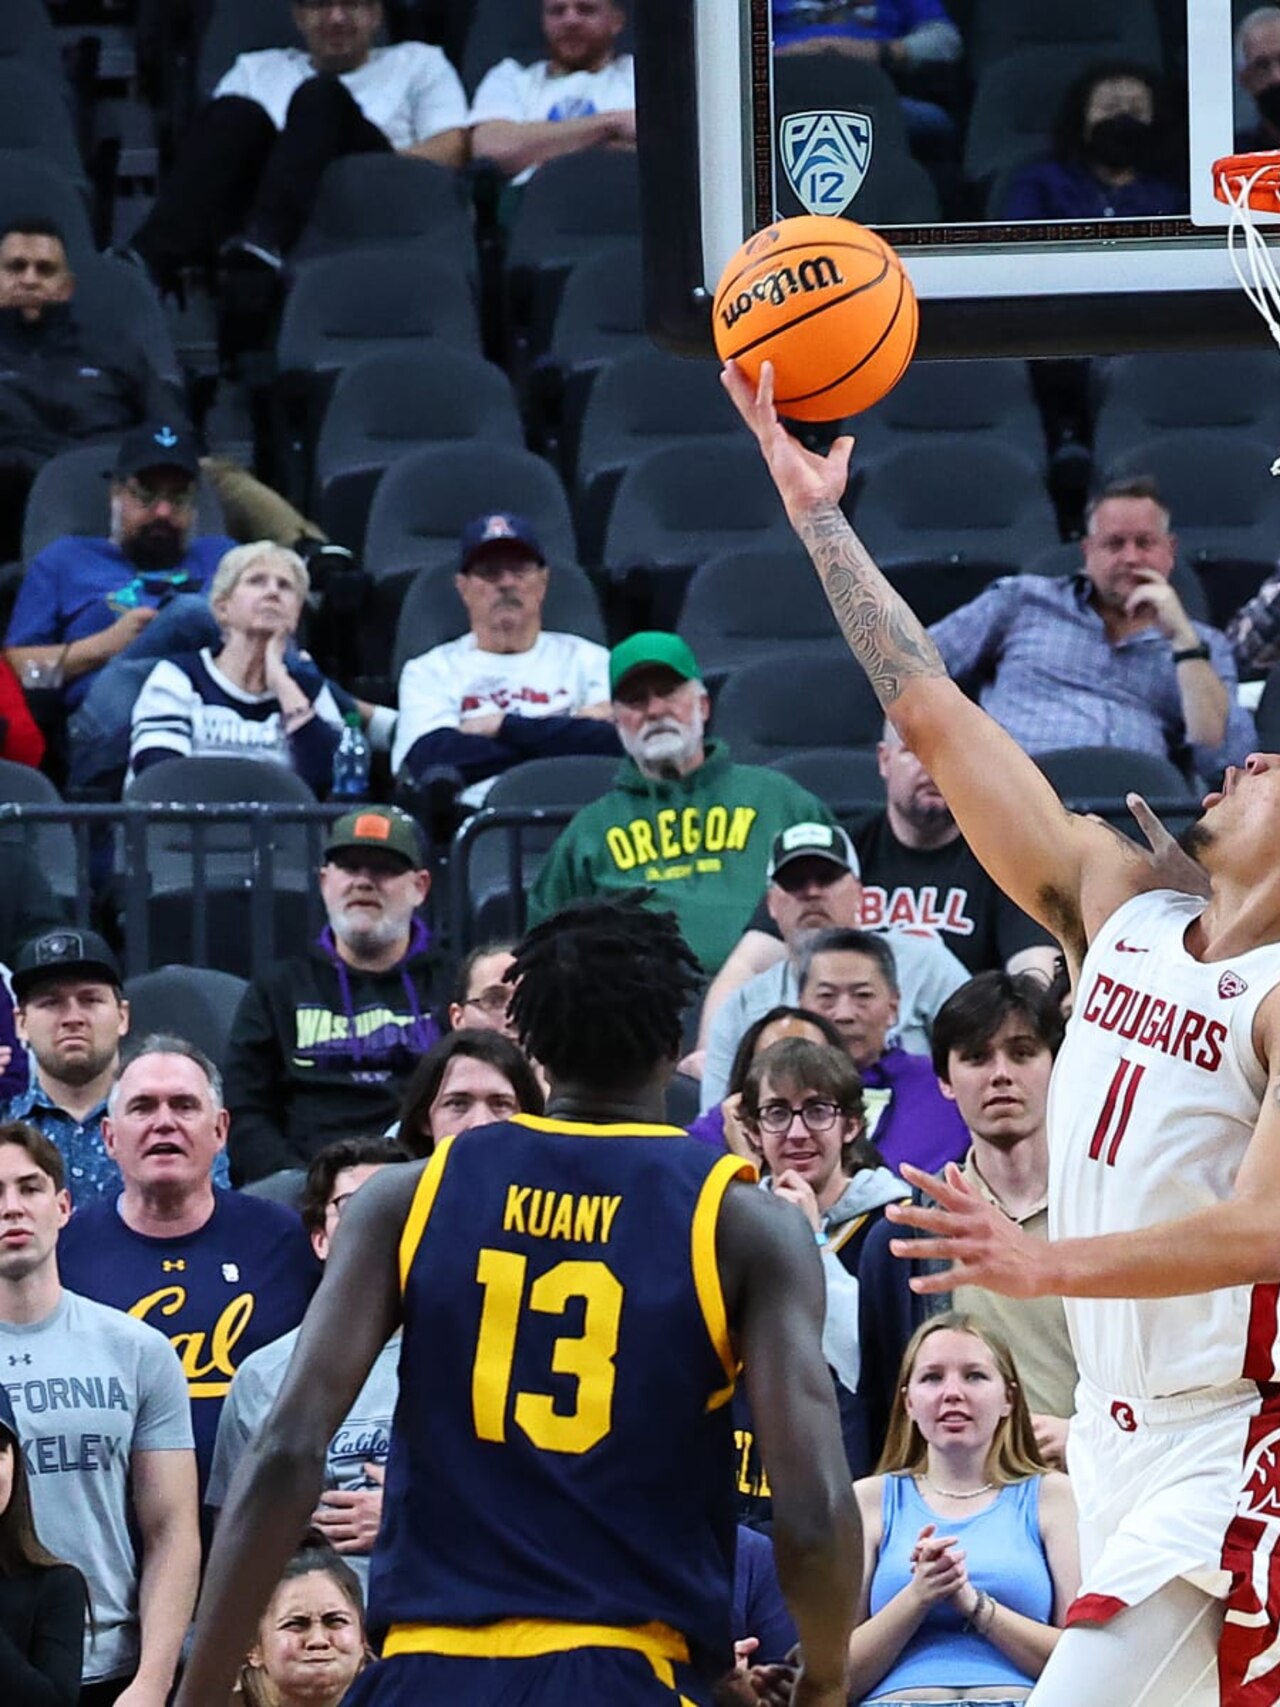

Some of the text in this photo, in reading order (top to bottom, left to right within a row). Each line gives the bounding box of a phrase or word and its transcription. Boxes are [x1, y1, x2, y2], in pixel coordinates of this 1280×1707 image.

[783, 113, 870, 181] PAC
[809, 171, 845, 204] 12
[722, 256, 843, 330] Wilson
[605, 805, 757, 871] OREGON
[861, 886, 976, 936] BALL
[1083, 972, 1229, 1073] COUGARS
[1088, 1057, 1147, 1167] 11
[503, 1184, 622, 1243] KUANY
[127, 1286, 254, 1380] Cal
[471, 1248, 625, 1455] 13
